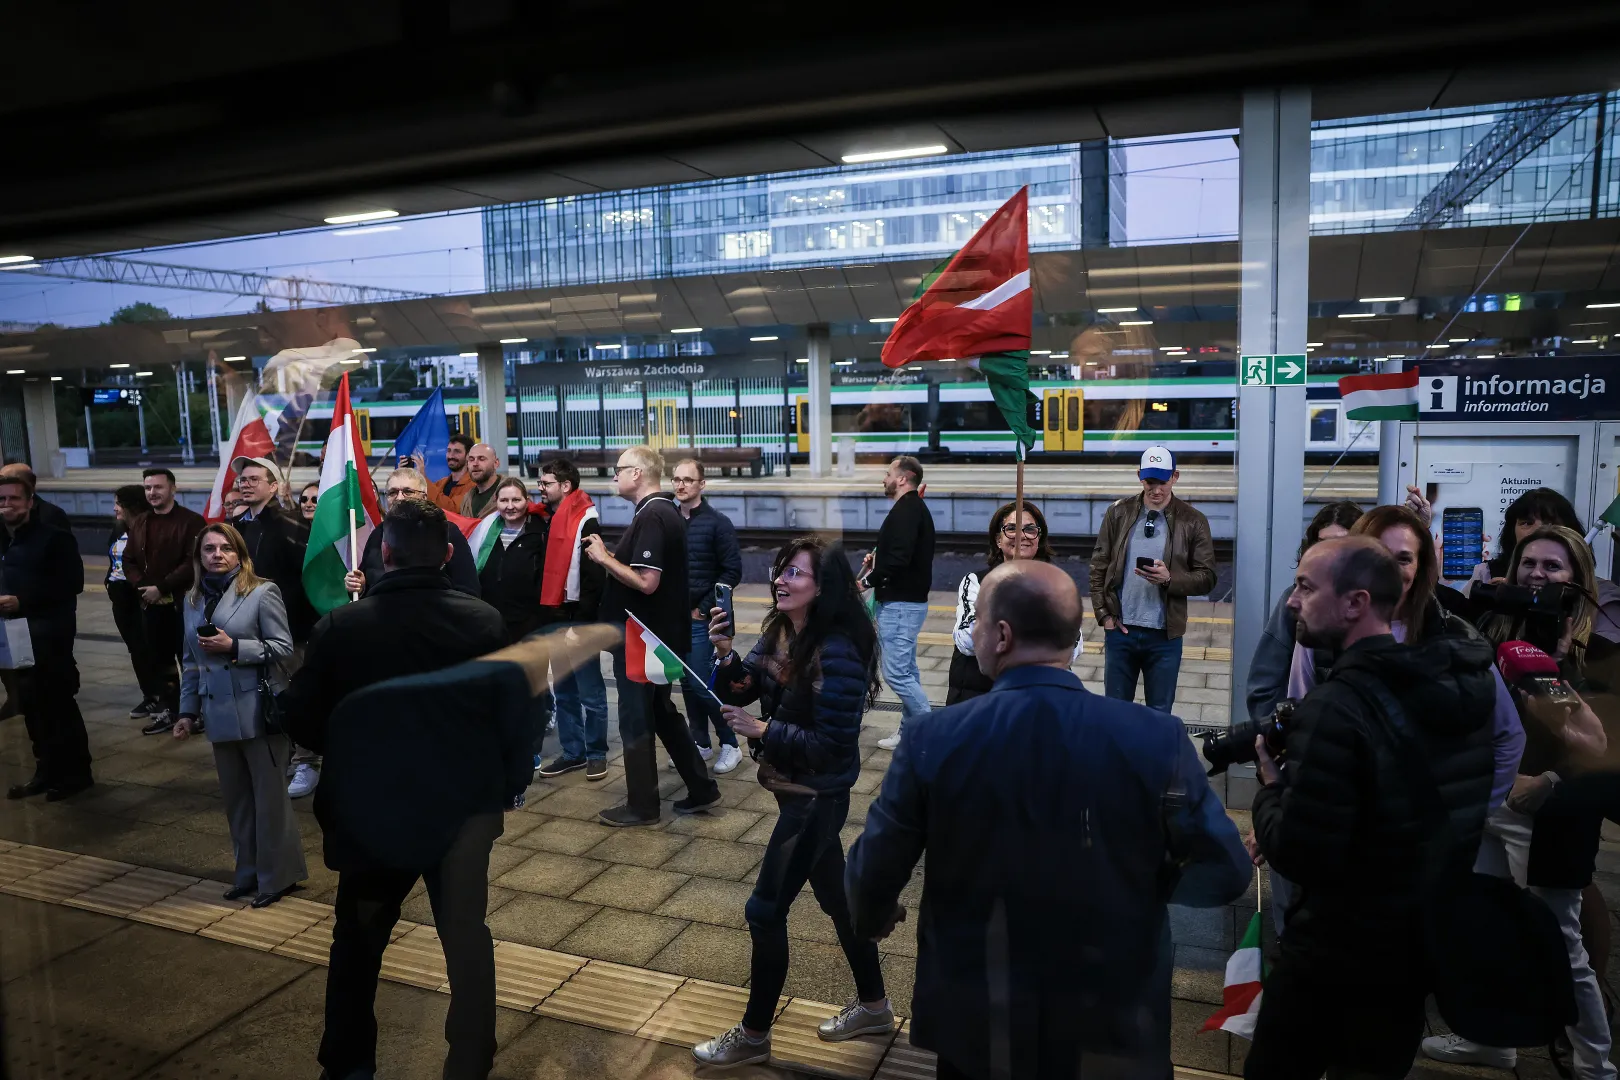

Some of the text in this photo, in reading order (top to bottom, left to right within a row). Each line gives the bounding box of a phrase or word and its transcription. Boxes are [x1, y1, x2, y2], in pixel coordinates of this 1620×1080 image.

[585, 363, 704, 378] Warszawa Zachodnia
[1464, 374, 1606, 399] informacja
[1035, 402, 1041, 411] 2
[1464, 400, 1549, 412] information
[1501, 477, 1542, 485] Aktualna
